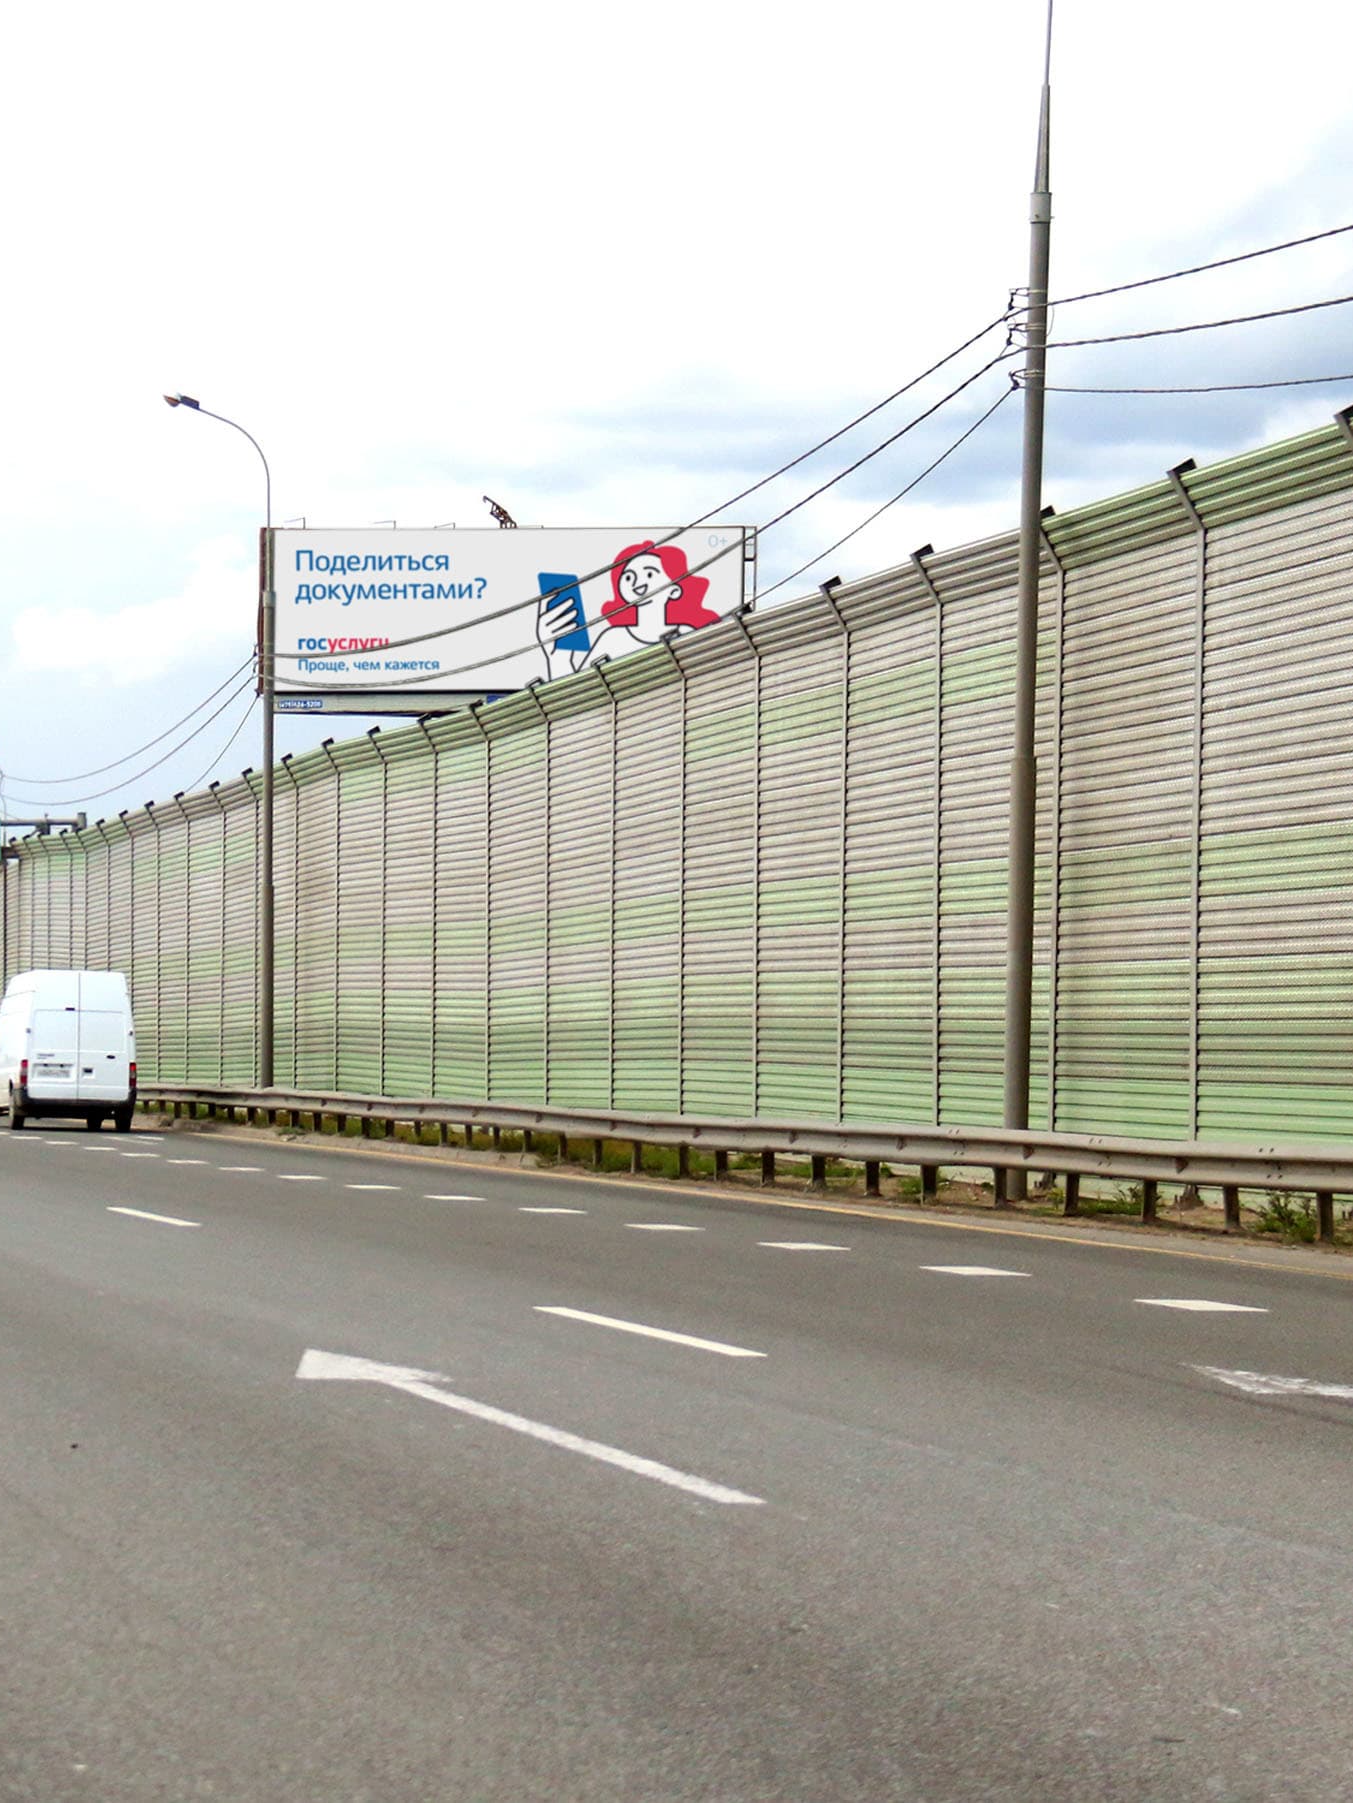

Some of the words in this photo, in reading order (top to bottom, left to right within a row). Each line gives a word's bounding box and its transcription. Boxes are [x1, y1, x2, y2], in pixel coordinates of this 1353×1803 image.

[295, 549, 450, 576] Поделиться
[294, 577, 488, 606] документами?
[297, 658, 350, 673] Проще,
[353, 660, 381, 671] чем
[384, 659, 440, 671] кажется
